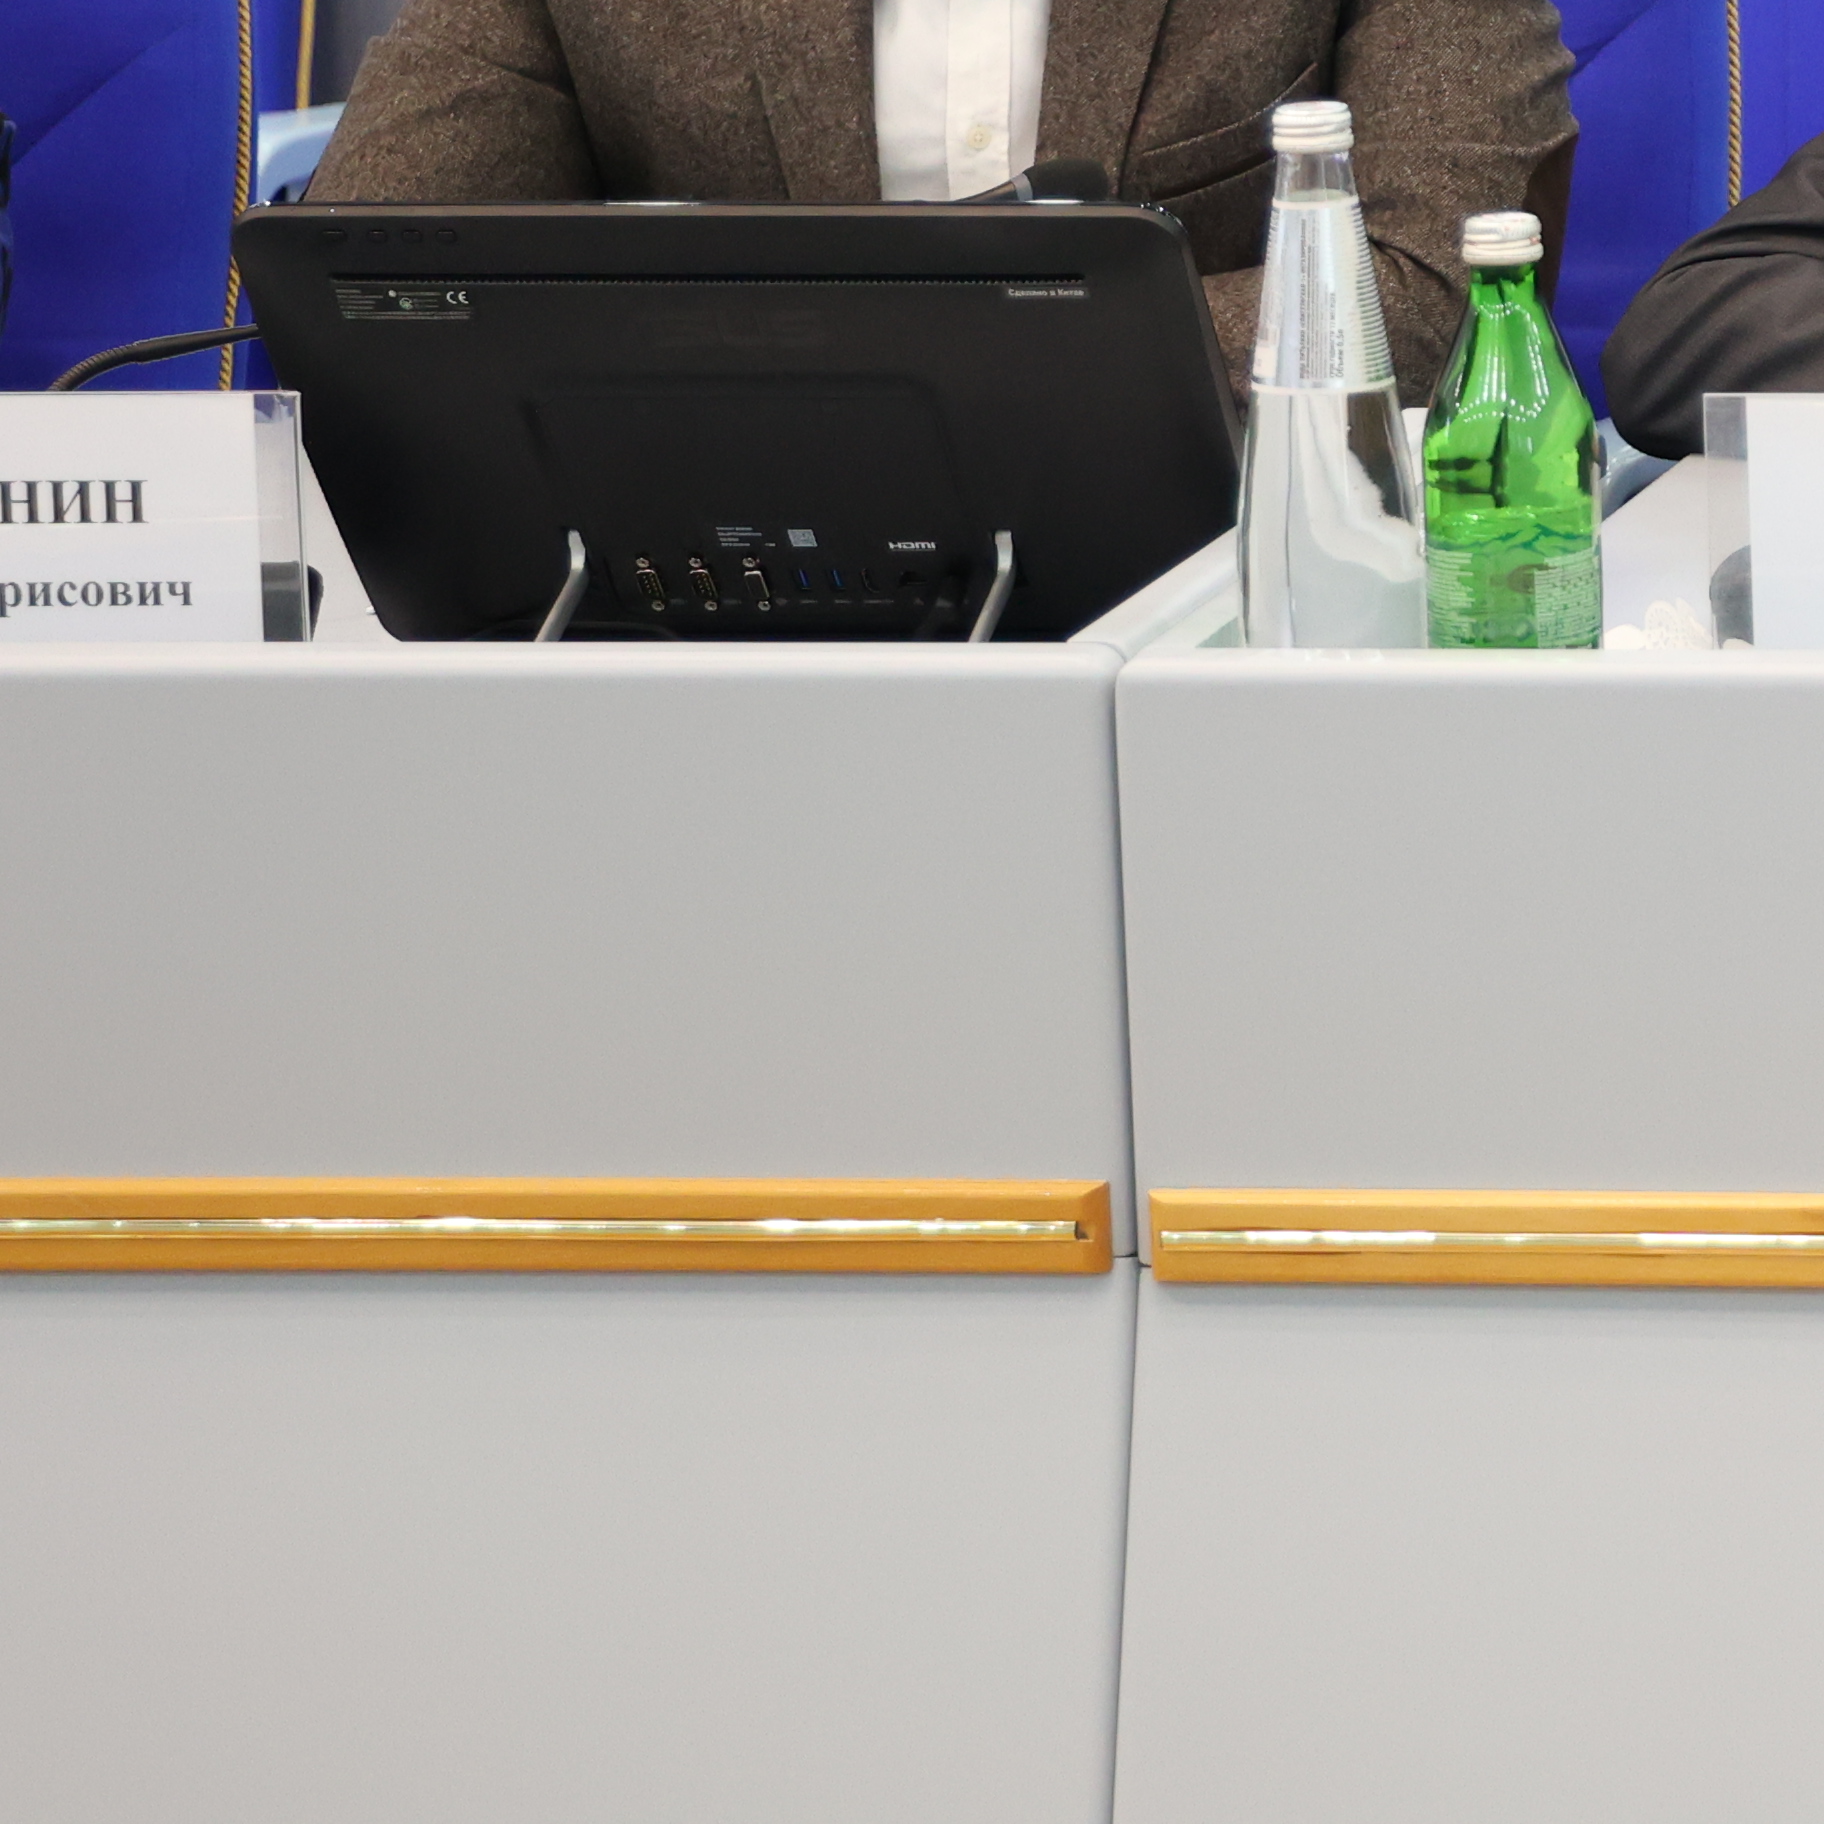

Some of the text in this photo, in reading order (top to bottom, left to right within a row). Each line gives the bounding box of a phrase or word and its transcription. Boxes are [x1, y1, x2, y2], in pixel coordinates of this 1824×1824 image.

[0, 479, 149, 524] НИН
[888, 541, 937, 550] HDMI
[0, 580, 193, 618] рисович
